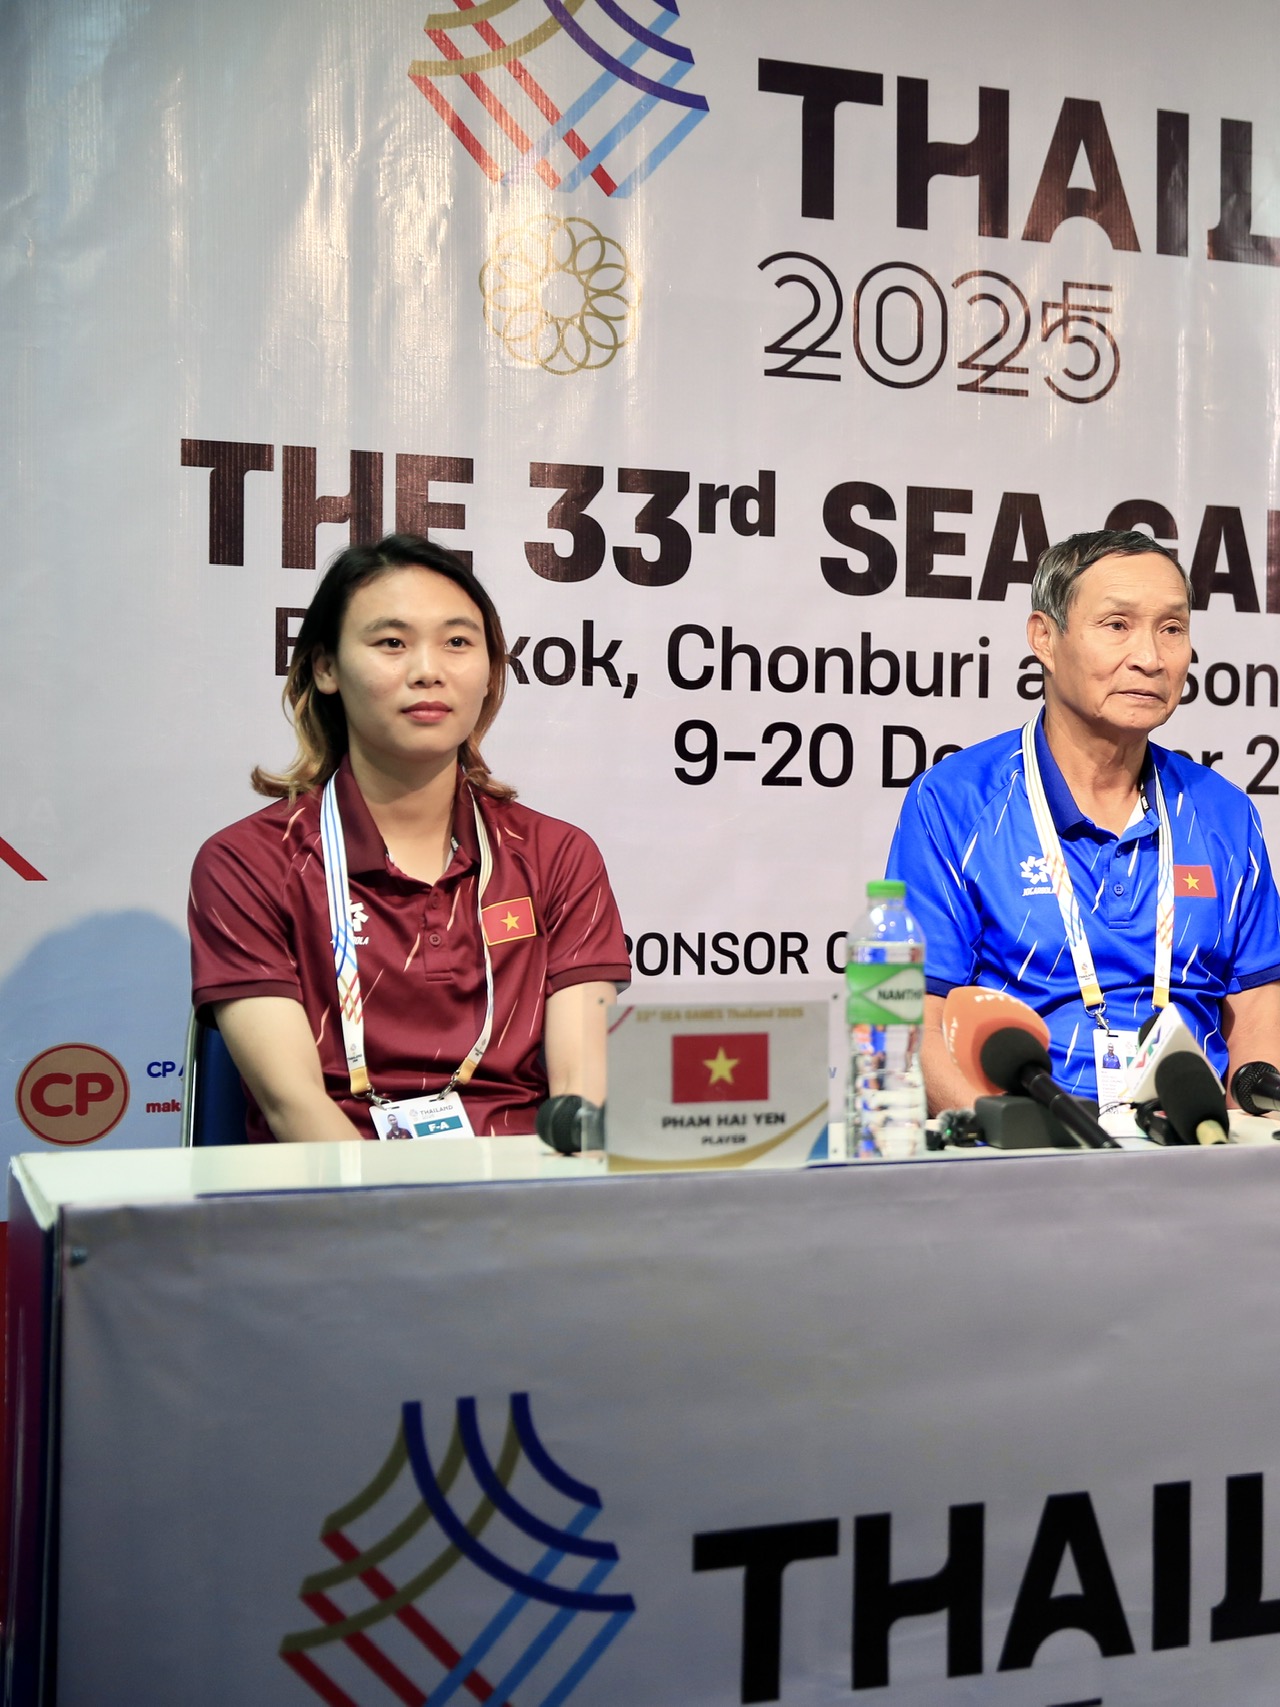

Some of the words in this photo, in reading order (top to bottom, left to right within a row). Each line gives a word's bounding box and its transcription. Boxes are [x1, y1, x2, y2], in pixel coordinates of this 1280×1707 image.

[757, 251, 1121, 404] 2025
[180, 439, 475, 573] THE
[524, 461, 776, 587] 33rd
[820, 481, 1051, 602] SEA
[667, 623, 990, 699] Chonburi
[673, 719, 854, 788] 9-20
[30, 1072, 114, 1117] CP
[147, 1061, 176, 1078] CP
[145, 1099, 182, 1113] mak
[419, 1104, 454, 1116] THAILAND
[428, 1121, 450, 1132] F-A
[661, 1115, 711, 1129] PHAM
[716, 1113, 747, 1127] HAI
[753, 1112, 786, 1126] YEN
[701, 1134, 747, 1146] PLAYER
